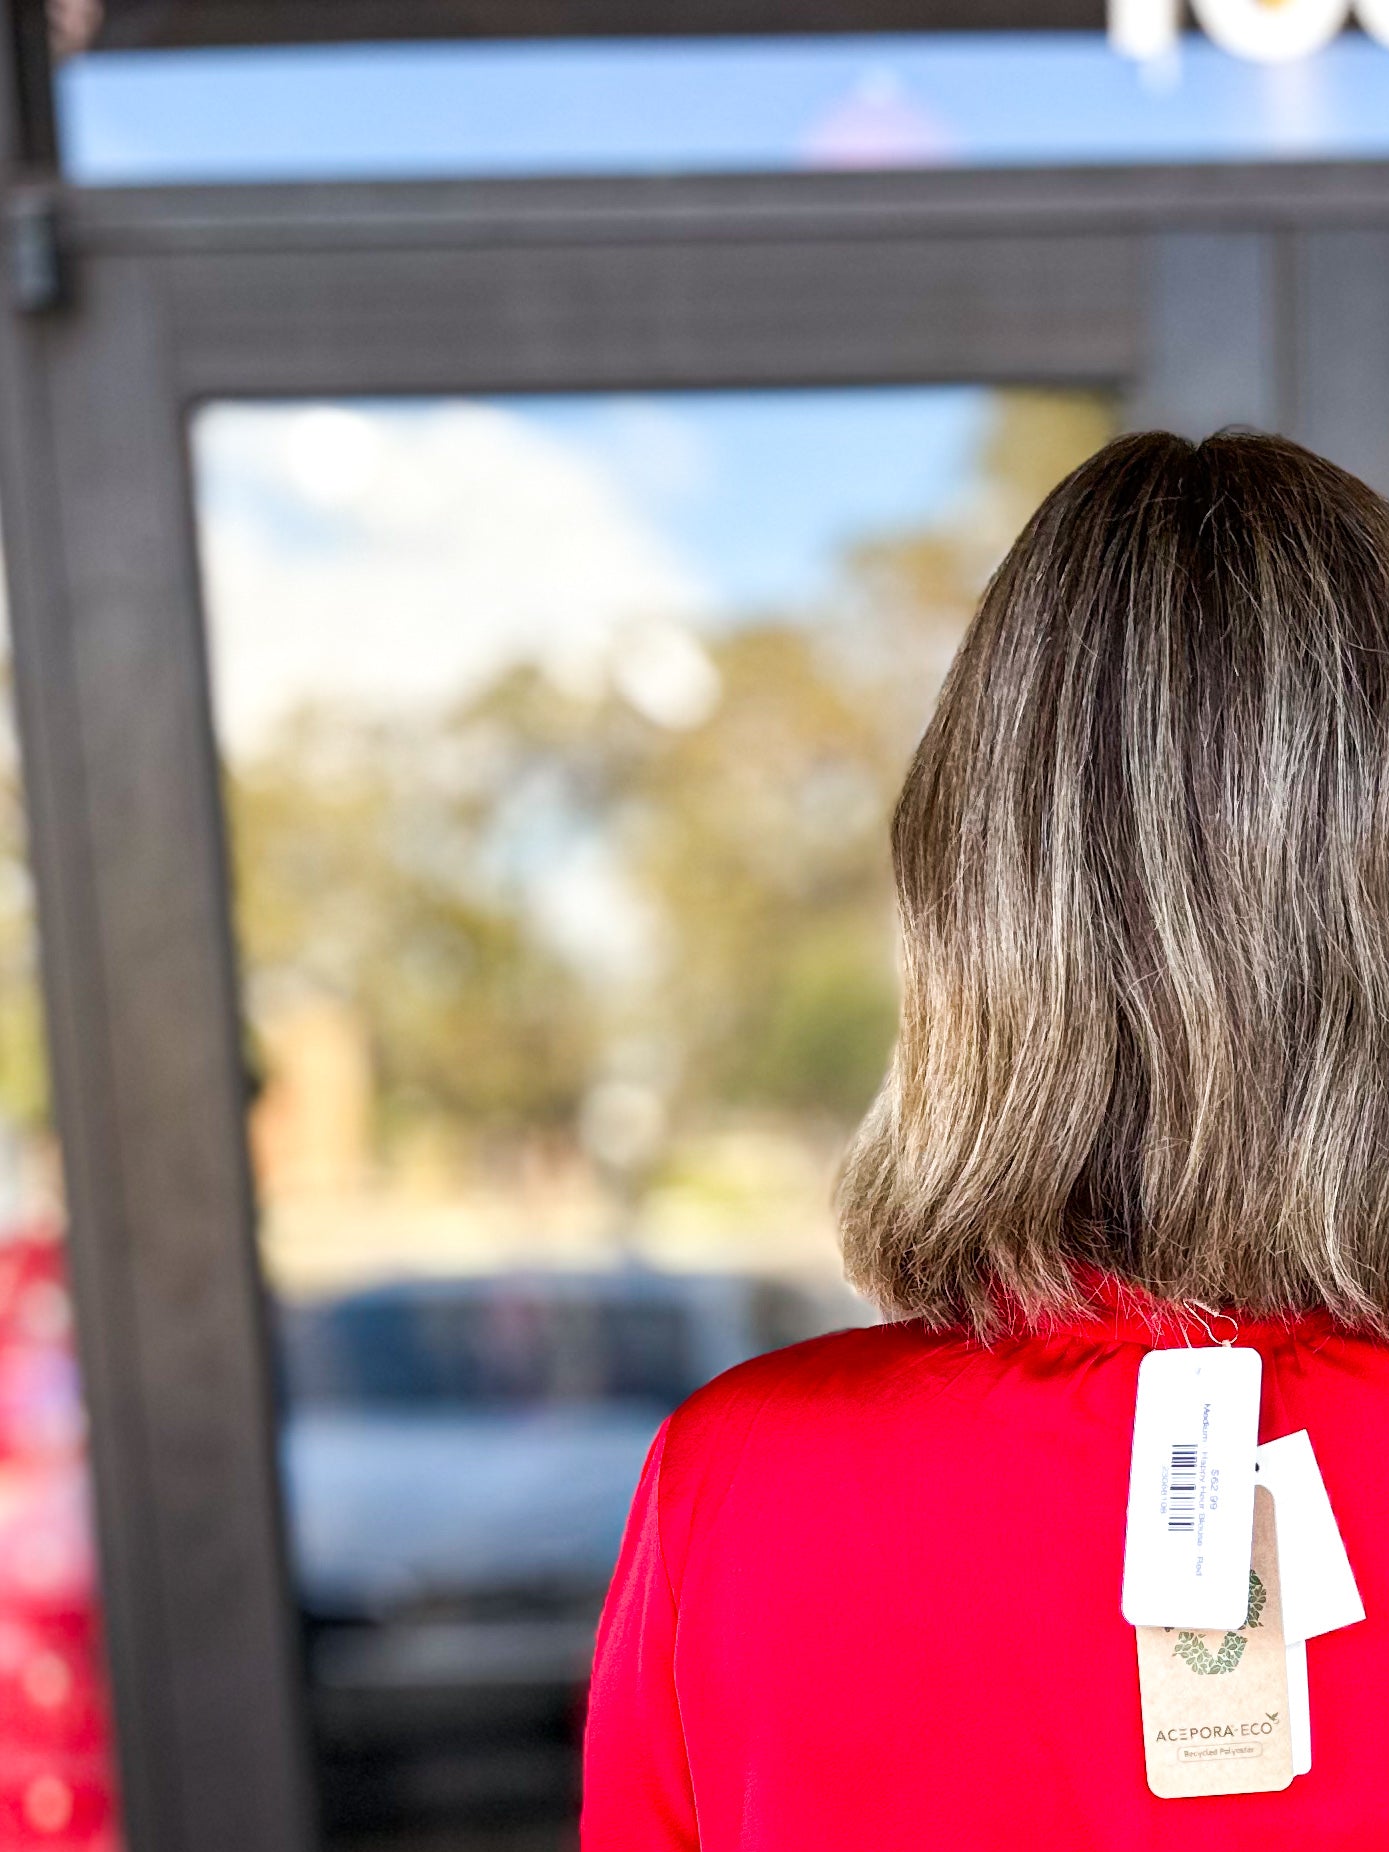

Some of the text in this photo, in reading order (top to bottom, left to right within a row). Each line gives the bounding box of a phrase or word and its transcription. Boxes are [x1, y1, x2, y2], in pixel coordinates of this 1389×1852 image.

[1199, 1452, 1208, 1482] Happy
[1210, 1469, 1219, 1510] $6299
[1184, 1747, 1254, 1758] Recycled Polyester
